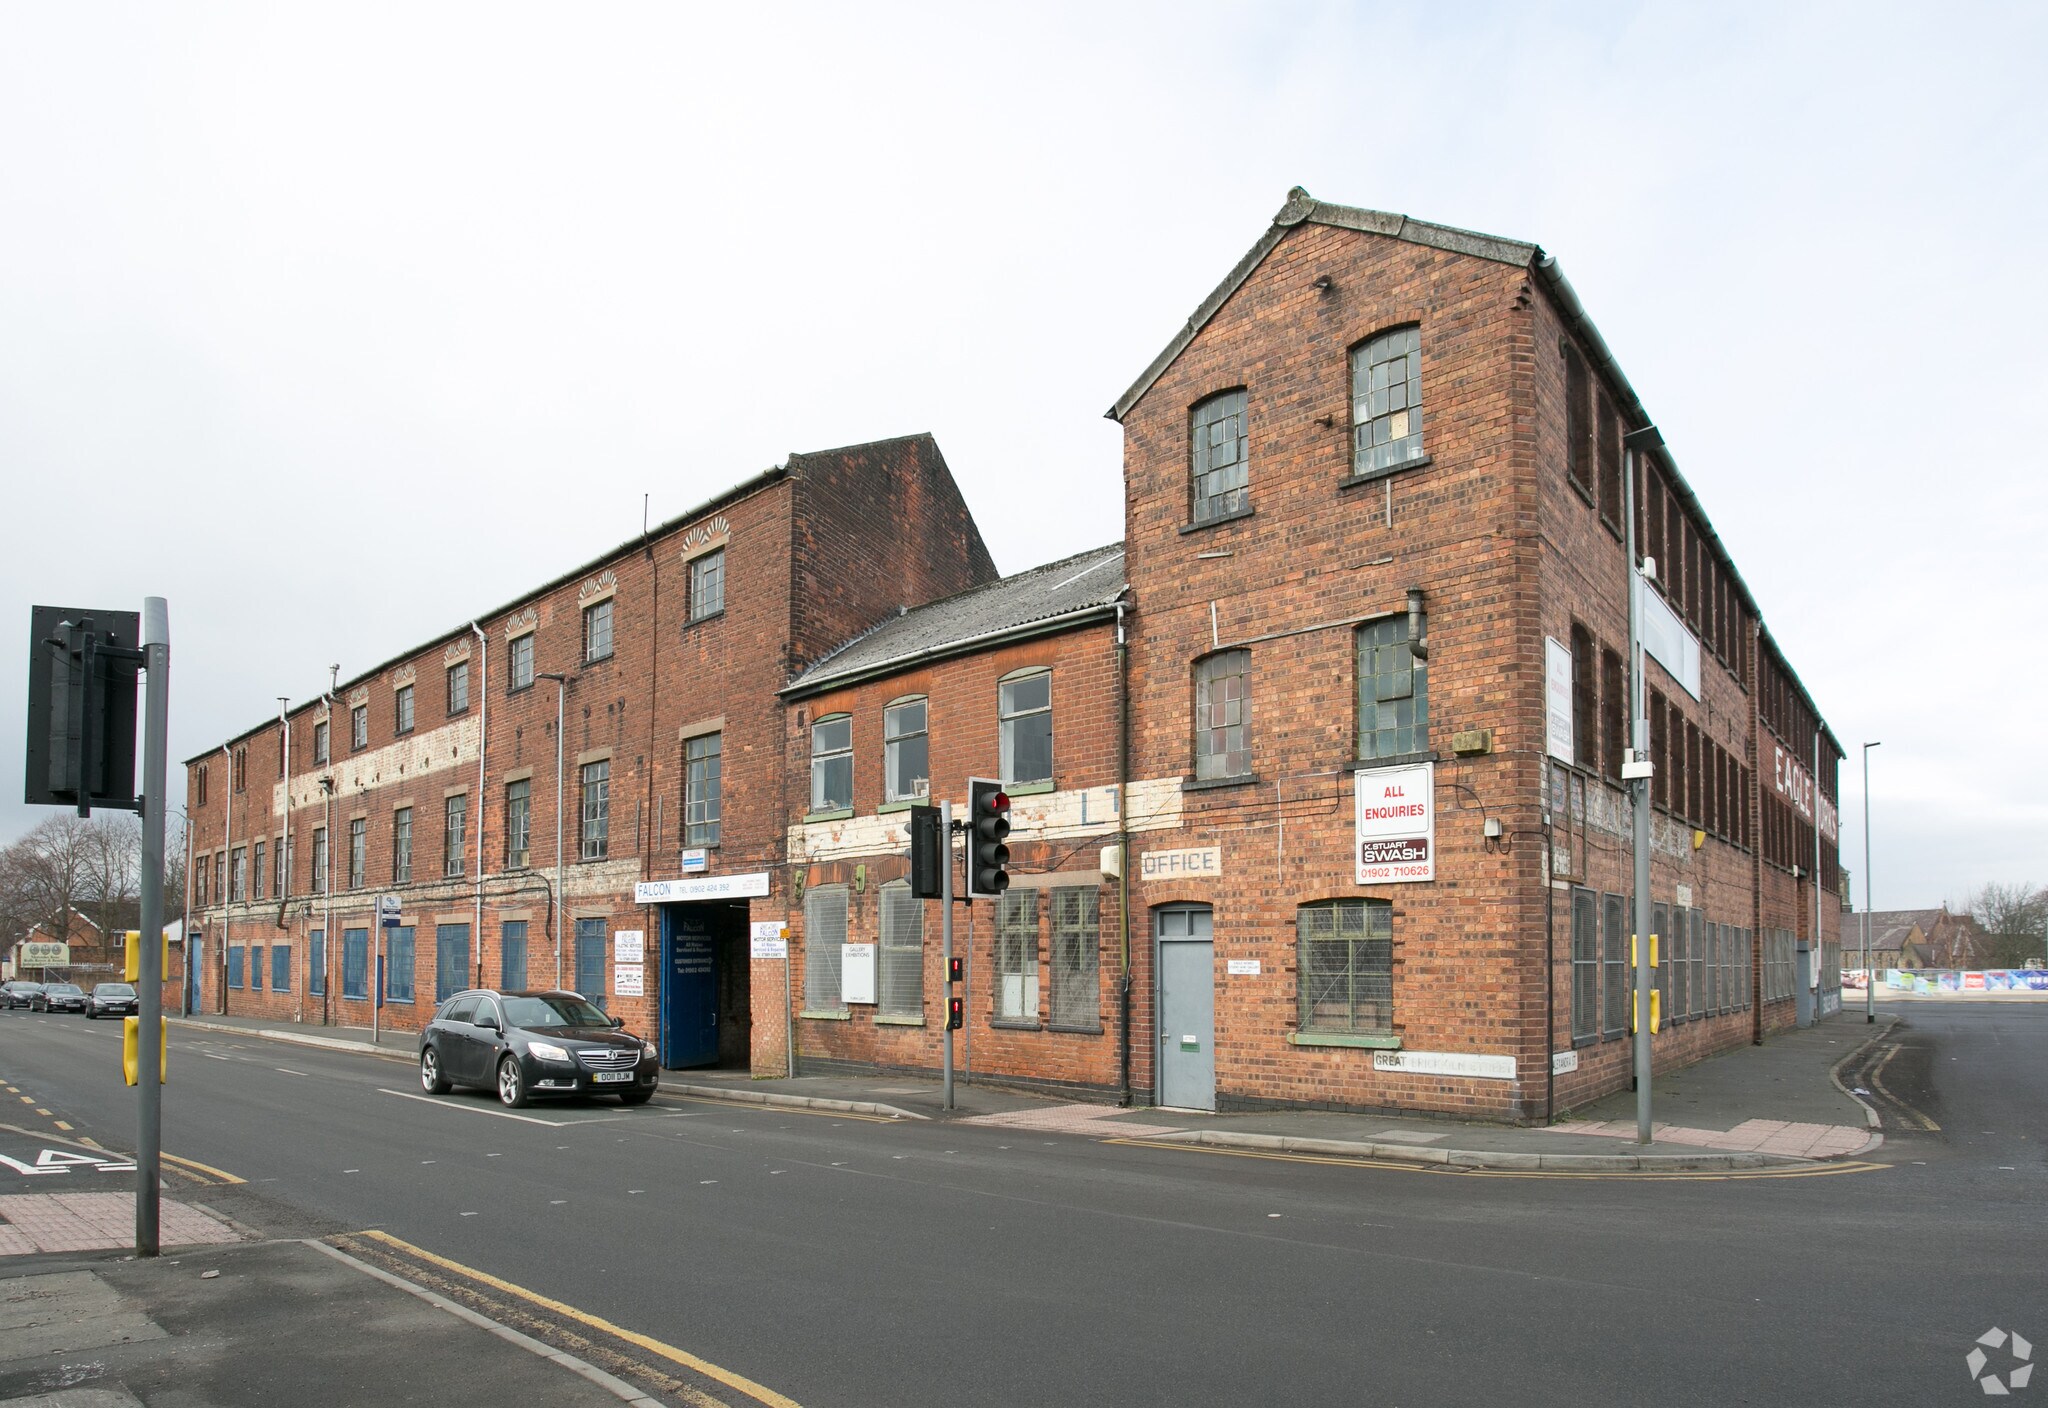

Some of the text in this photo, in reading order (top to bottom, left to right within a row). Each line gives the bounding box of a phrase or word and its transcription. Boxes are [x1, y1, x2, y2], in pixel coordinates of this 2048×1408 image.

[1775, 746, 1811, 817] EAGLE
[1384, 786, 1405, 798] ALL
[1365, 803, 1425, 820] ENQUIRIES
[1819, 793, 1837, 841] ORKS
[1364, 841, 1408, 851] K.STUART
[1364, 847, 1426, 862] SWASH
[1144, 852, 1214, 874] OFFICE
[1361, 865, 1429, 878] 01902 710626
[638, 883, 671, 897] FALCON
[1375, 1054, 1407, 1067] GREAT
